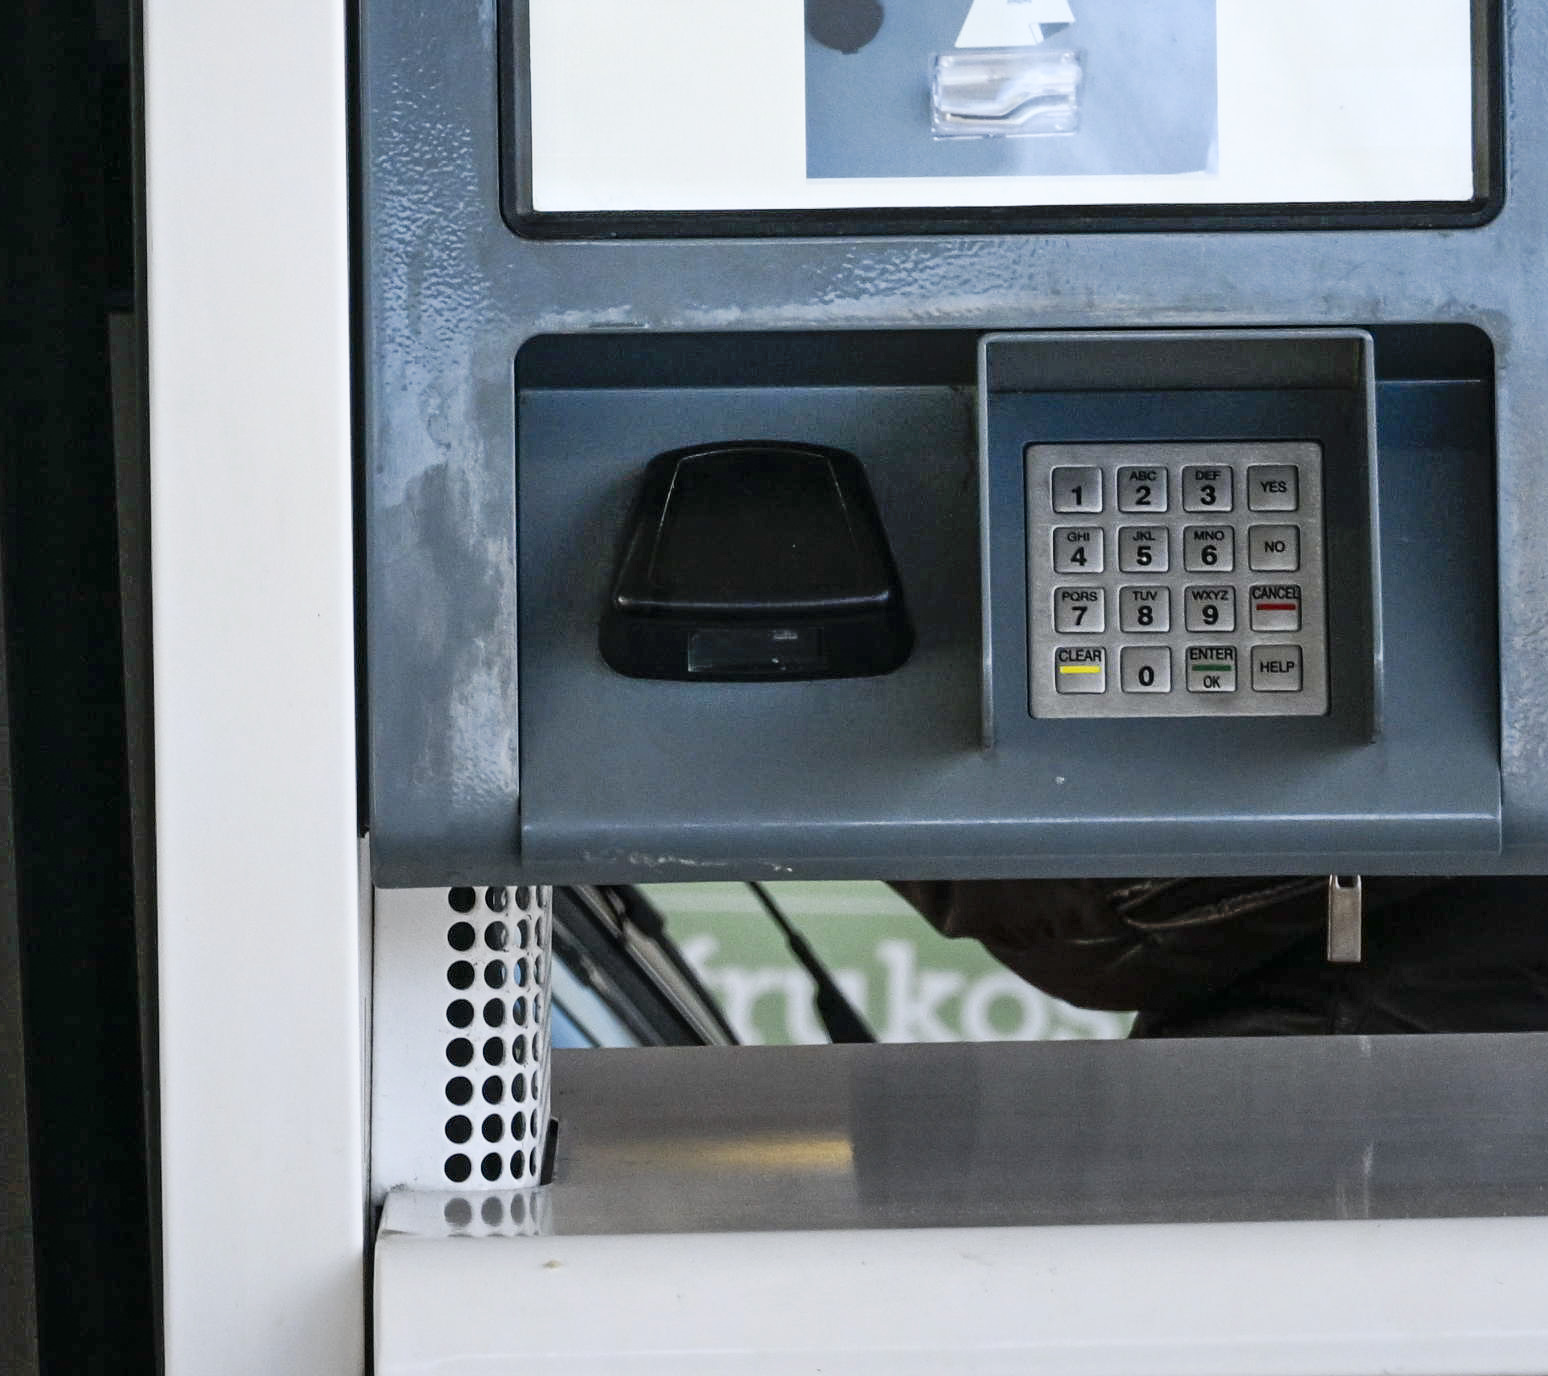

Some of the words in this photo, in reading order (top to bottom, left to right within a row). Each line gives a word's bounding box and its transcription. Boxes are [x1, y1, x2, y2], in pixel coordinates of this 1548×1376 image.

[1260, 480, 1287, 493] YES
[1264, 541, 1285, 553] NO
[1252, 587, 1300, 599] CANCEL
[1059, 649, 1101, 662] CLEAR
[1189, 648, 1233, 661] ENTER
[1260, 661, 1295, 673] HELP
[1203, 676, 1220, 688] OK
